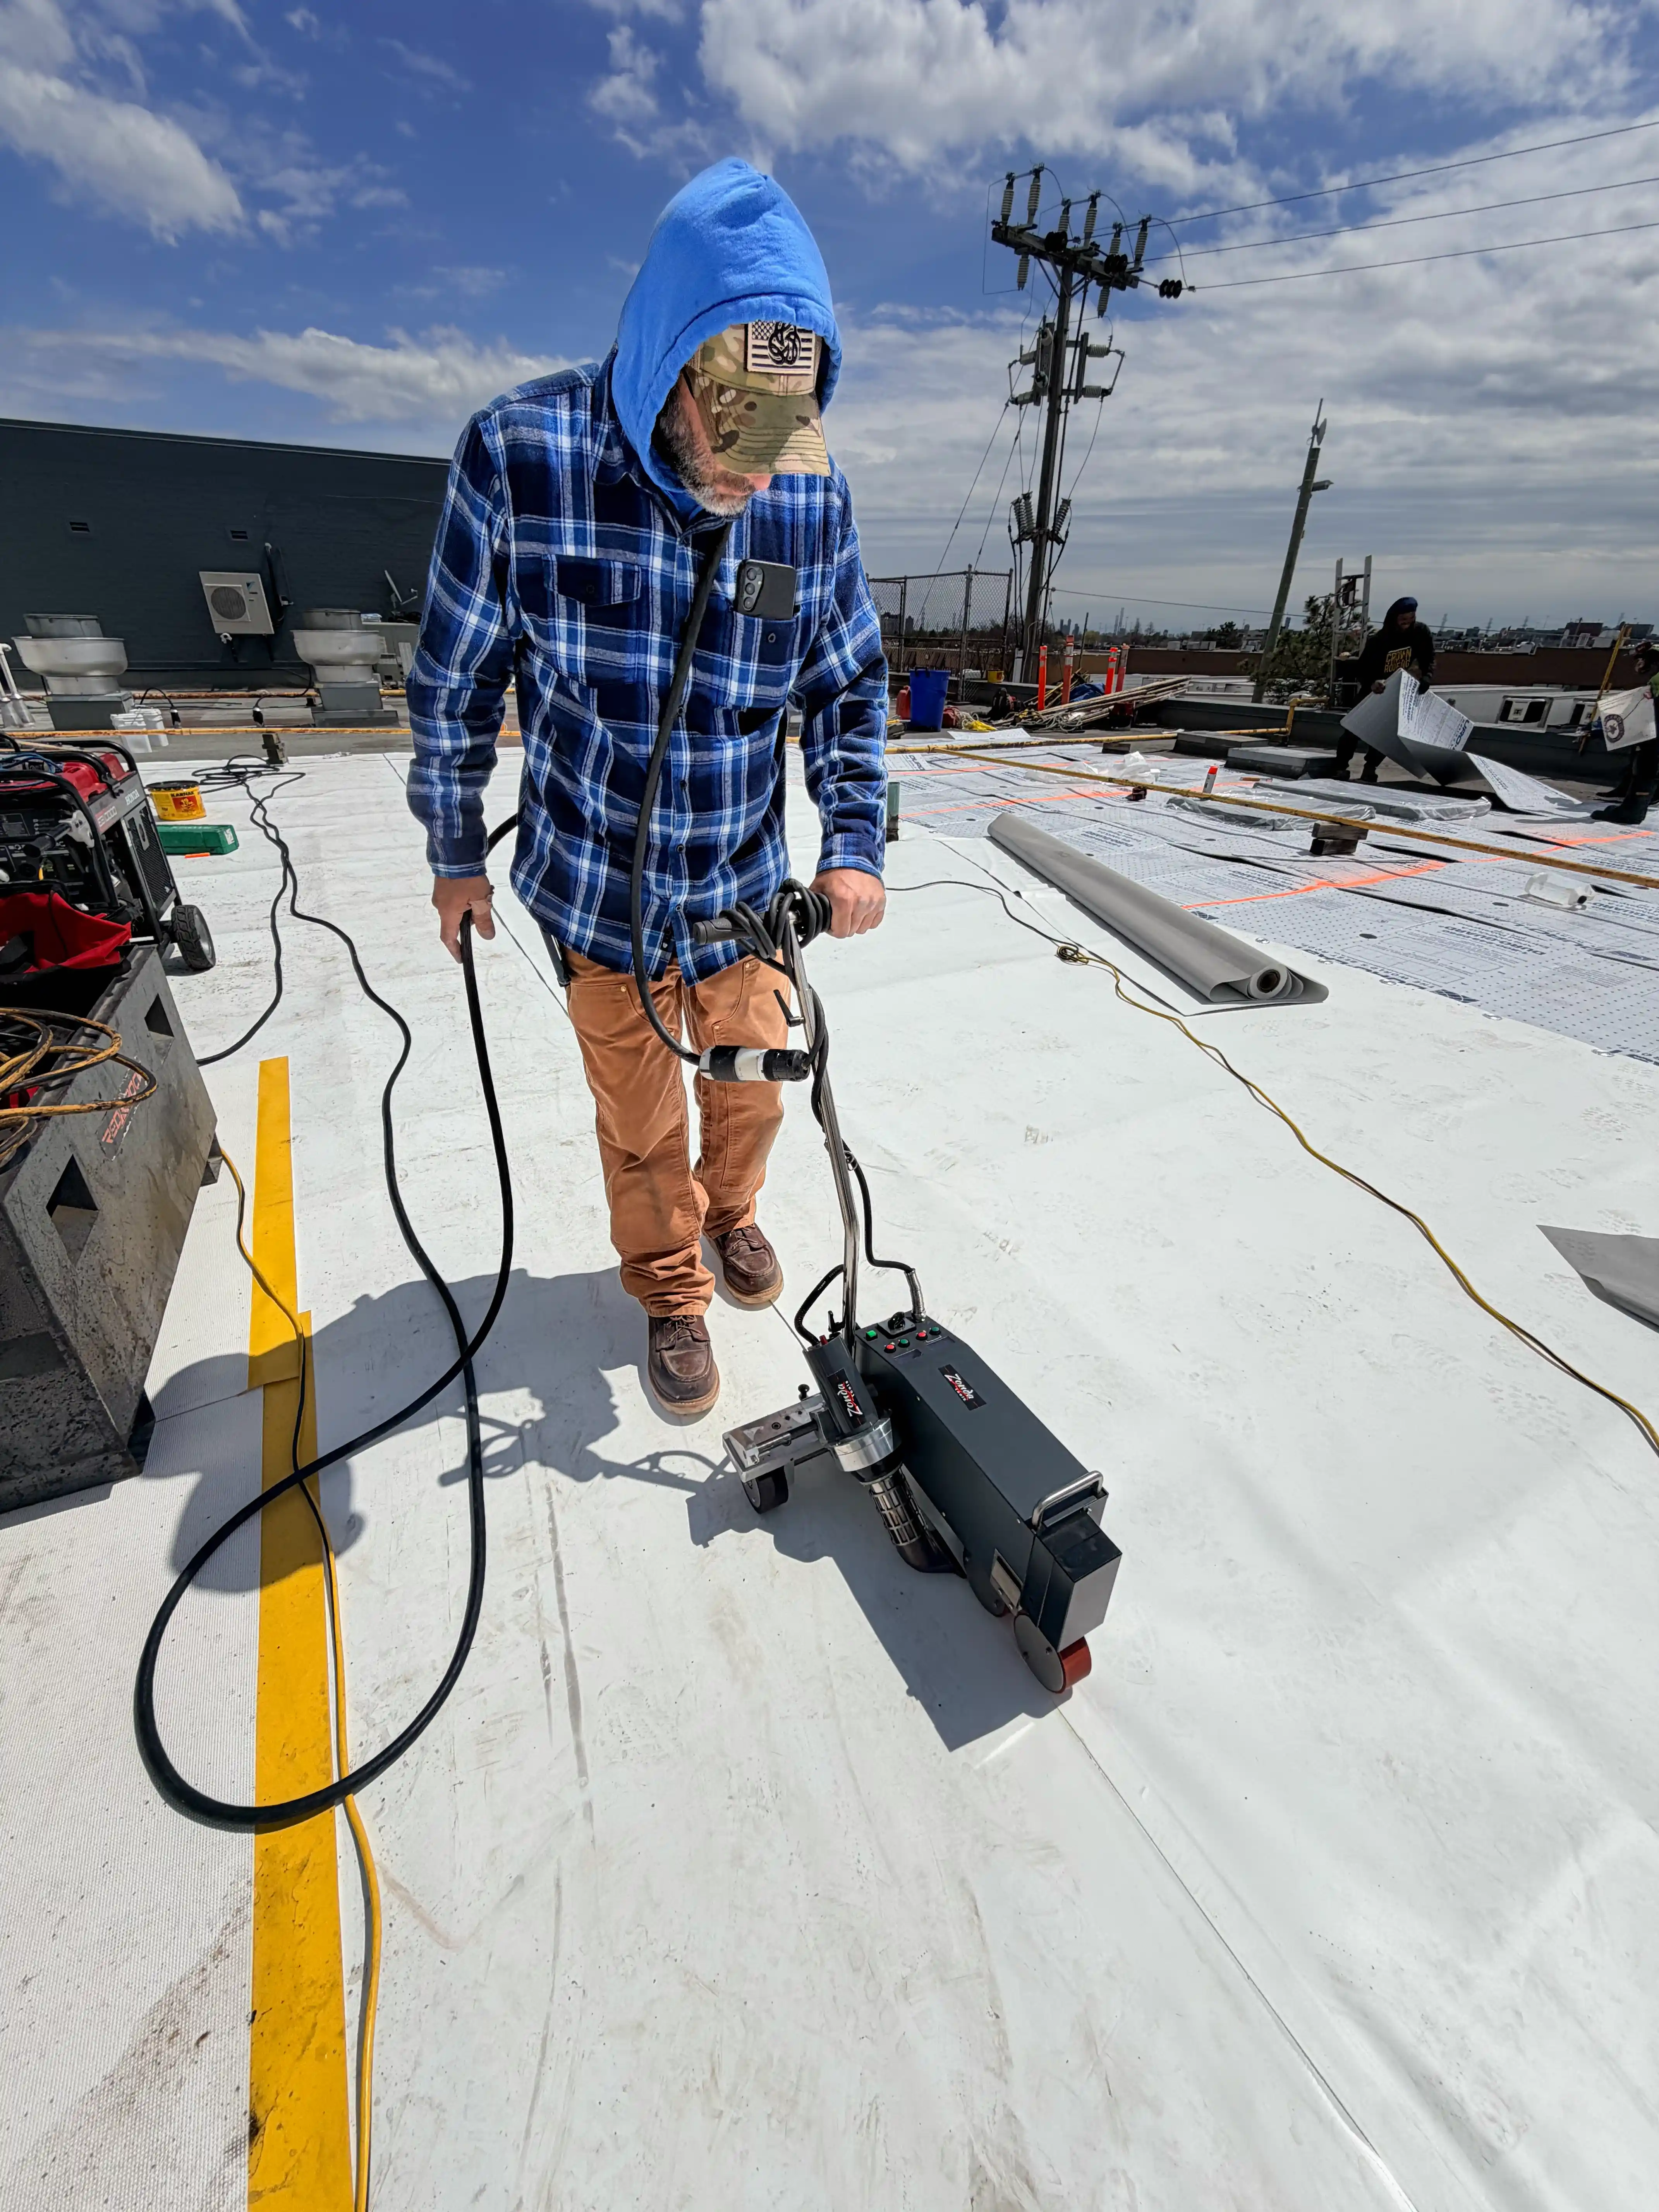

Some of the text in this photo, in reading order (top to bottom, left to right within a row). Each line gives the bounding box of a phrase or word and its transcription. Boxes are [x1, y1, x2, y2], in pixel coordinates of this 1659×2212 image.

[1386, 647, 1412, 662] CROWN
[125, 789, 140, 805] HONDA
[944, 1374, 974, 1399] Zonda
[837, 1383, 863, 1417] Zonda
